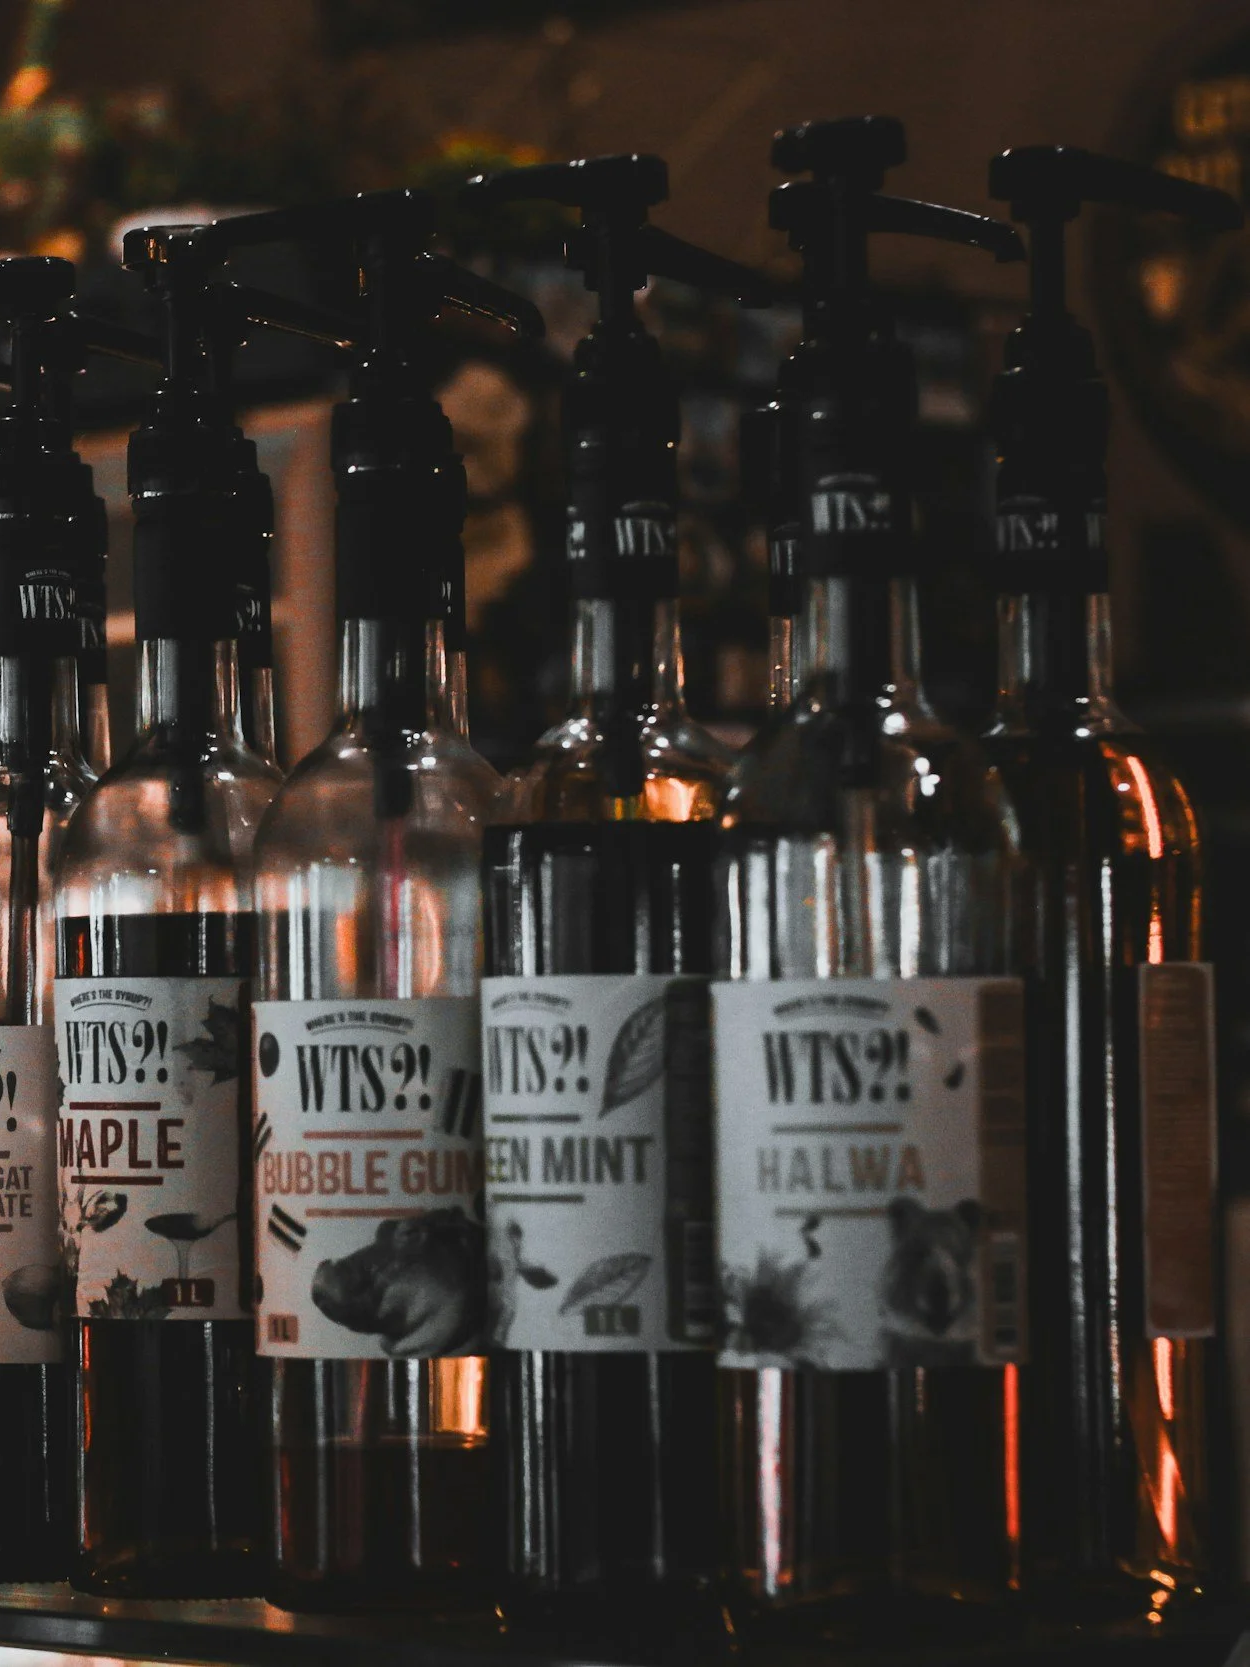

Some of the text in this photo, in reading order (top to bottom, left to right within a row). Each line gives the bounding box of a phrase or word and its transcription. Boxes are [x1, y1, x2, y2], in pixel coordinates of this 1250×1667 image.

[98, 989, 113, 1000] THE
[66, 1019, 169, 1085] WTS?!
[762, 1029, 911, 1104] WTS?!
[295, 1043, 433, 1113] WTS?!
[56, 1118, 185, 1169] MAPLE
[542, 1134, 654, 1184] MINT
[755, 1143, 925, 1193] HALWA
[263, 1150, 389, 1195] BUBBLE
[173, 1282, 201, 1304] 1L
[271, 1317, 292, 1342] 1L
